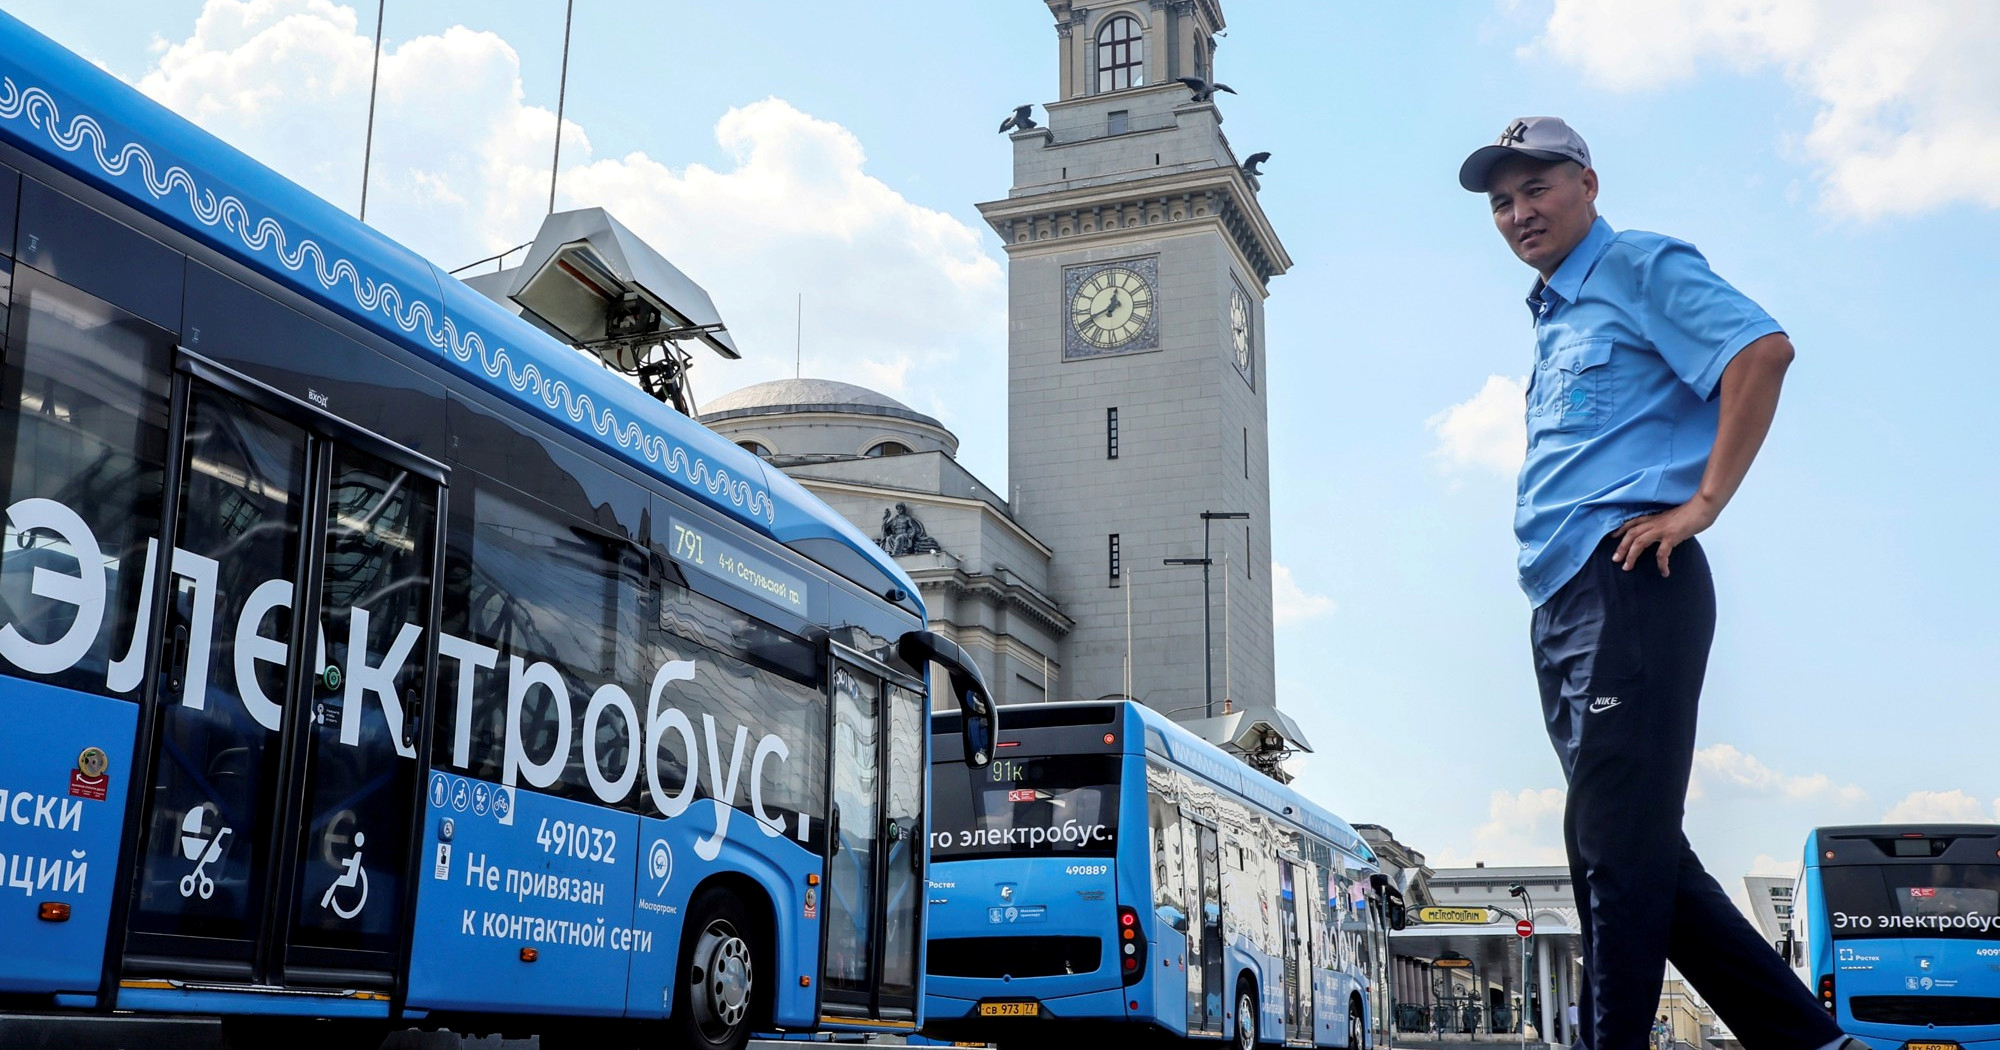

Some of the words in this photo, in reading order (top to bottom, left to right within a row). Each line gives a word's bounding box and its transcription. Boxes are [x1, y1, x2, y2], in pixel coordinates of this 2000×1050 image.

[674, 524, 704, 565] 791
[719, 553, 734, 573] 4-й
[737, 562, 787, 598] Сетуньский
[789, 590, 801, 605] пр.
[1594, 697, 1618, 705] NIKE
[536, 817, 616, 864] 491032
[959, 819, 1113, 848] электробус.
[466, 852, 500, 891] Не
[505, 868, 605, 905] привязан
[1066, 865, 1107, 875] 490889
[928, 881, 956, 889] Ростех
[639, 899, 677, 915] Мосгортранс
[1428, 909, 1479, 921] METROPOLITAIN
[1833, 912, 1872, 929] Это
[462, 910, 475, 935] к
[482, 912, 605, 948] контактной
[610, 927, 653, 952] сети
[1001, 1004, 1019, 1014] 973
[1024, 1003, 1034, 1011] 77
